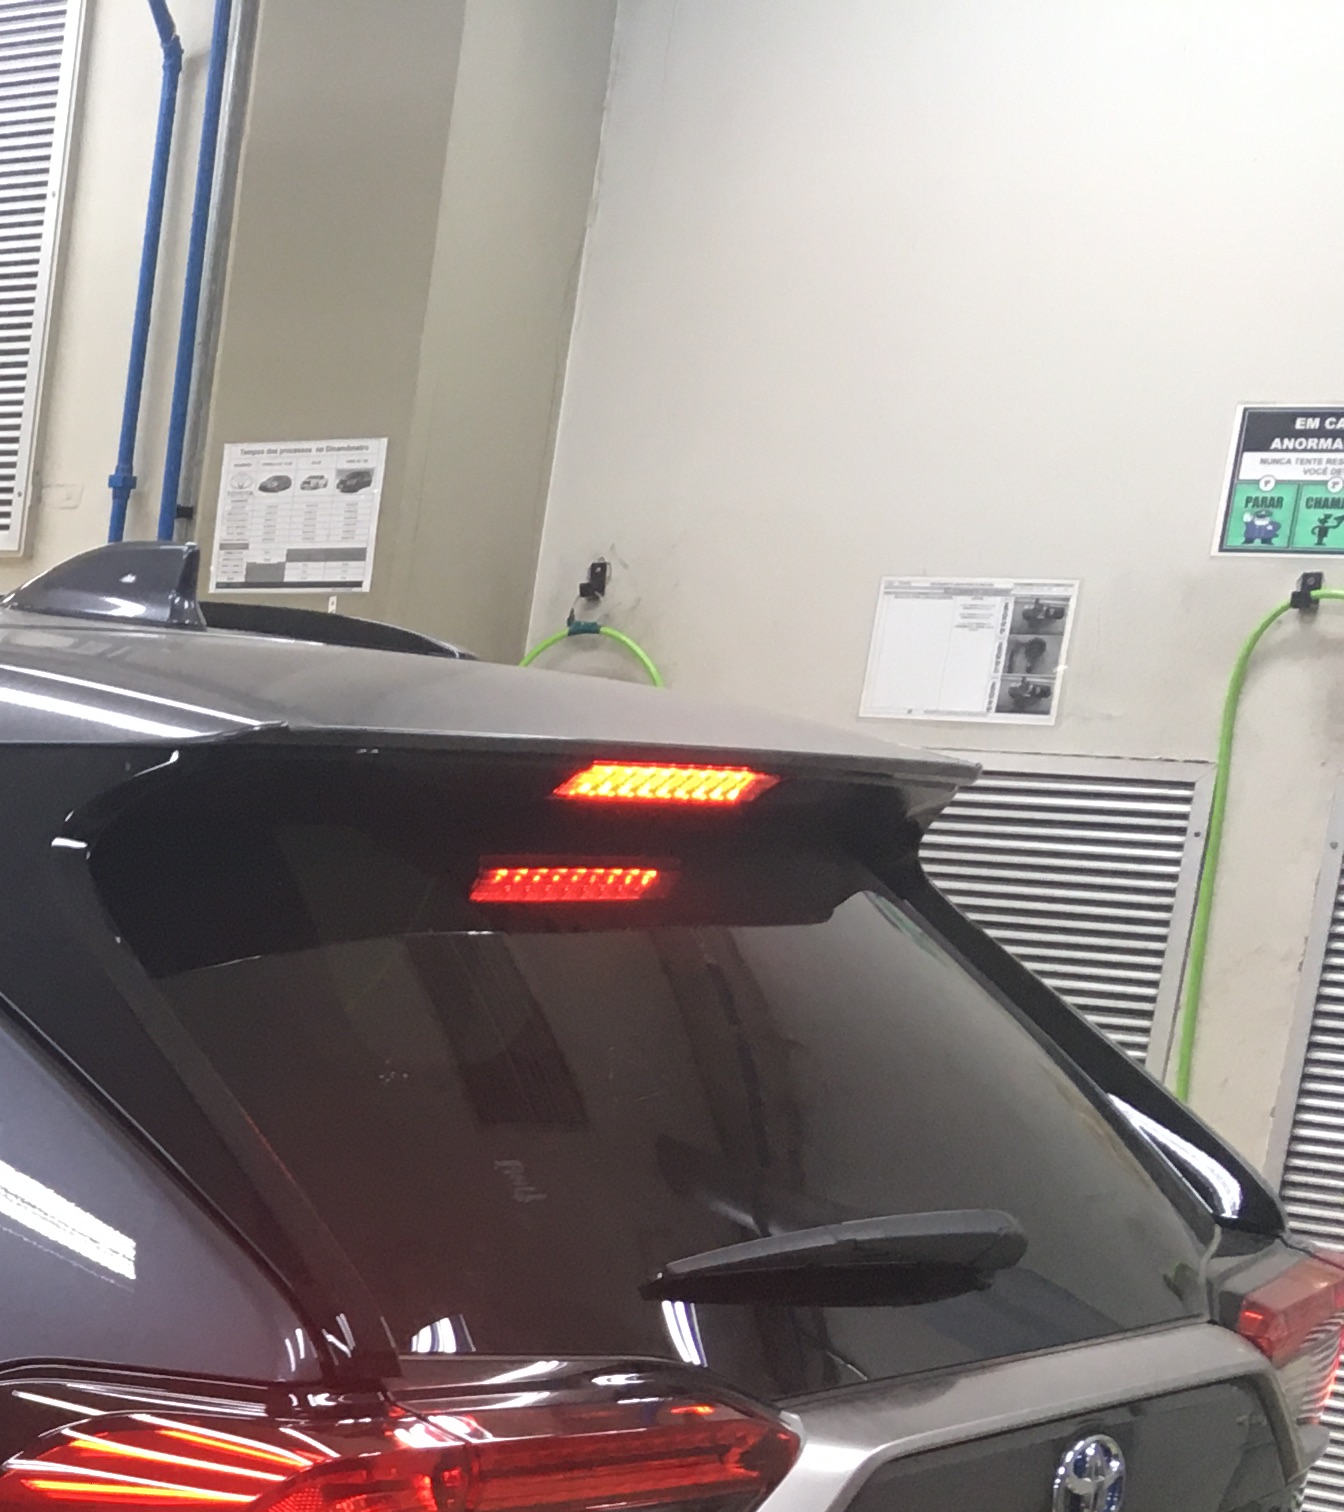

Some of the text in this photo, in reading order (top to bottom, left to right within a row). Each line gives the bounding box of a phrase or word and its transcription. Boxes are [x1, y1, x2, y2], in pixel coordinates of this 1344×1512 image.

[1295, 417, 1320, 430] EM
[1259, 457, 1292, 465] NUNCA
[1295, 457, 1323, 465] TENTE
[1244, 496, 1284, 508] PARAR
